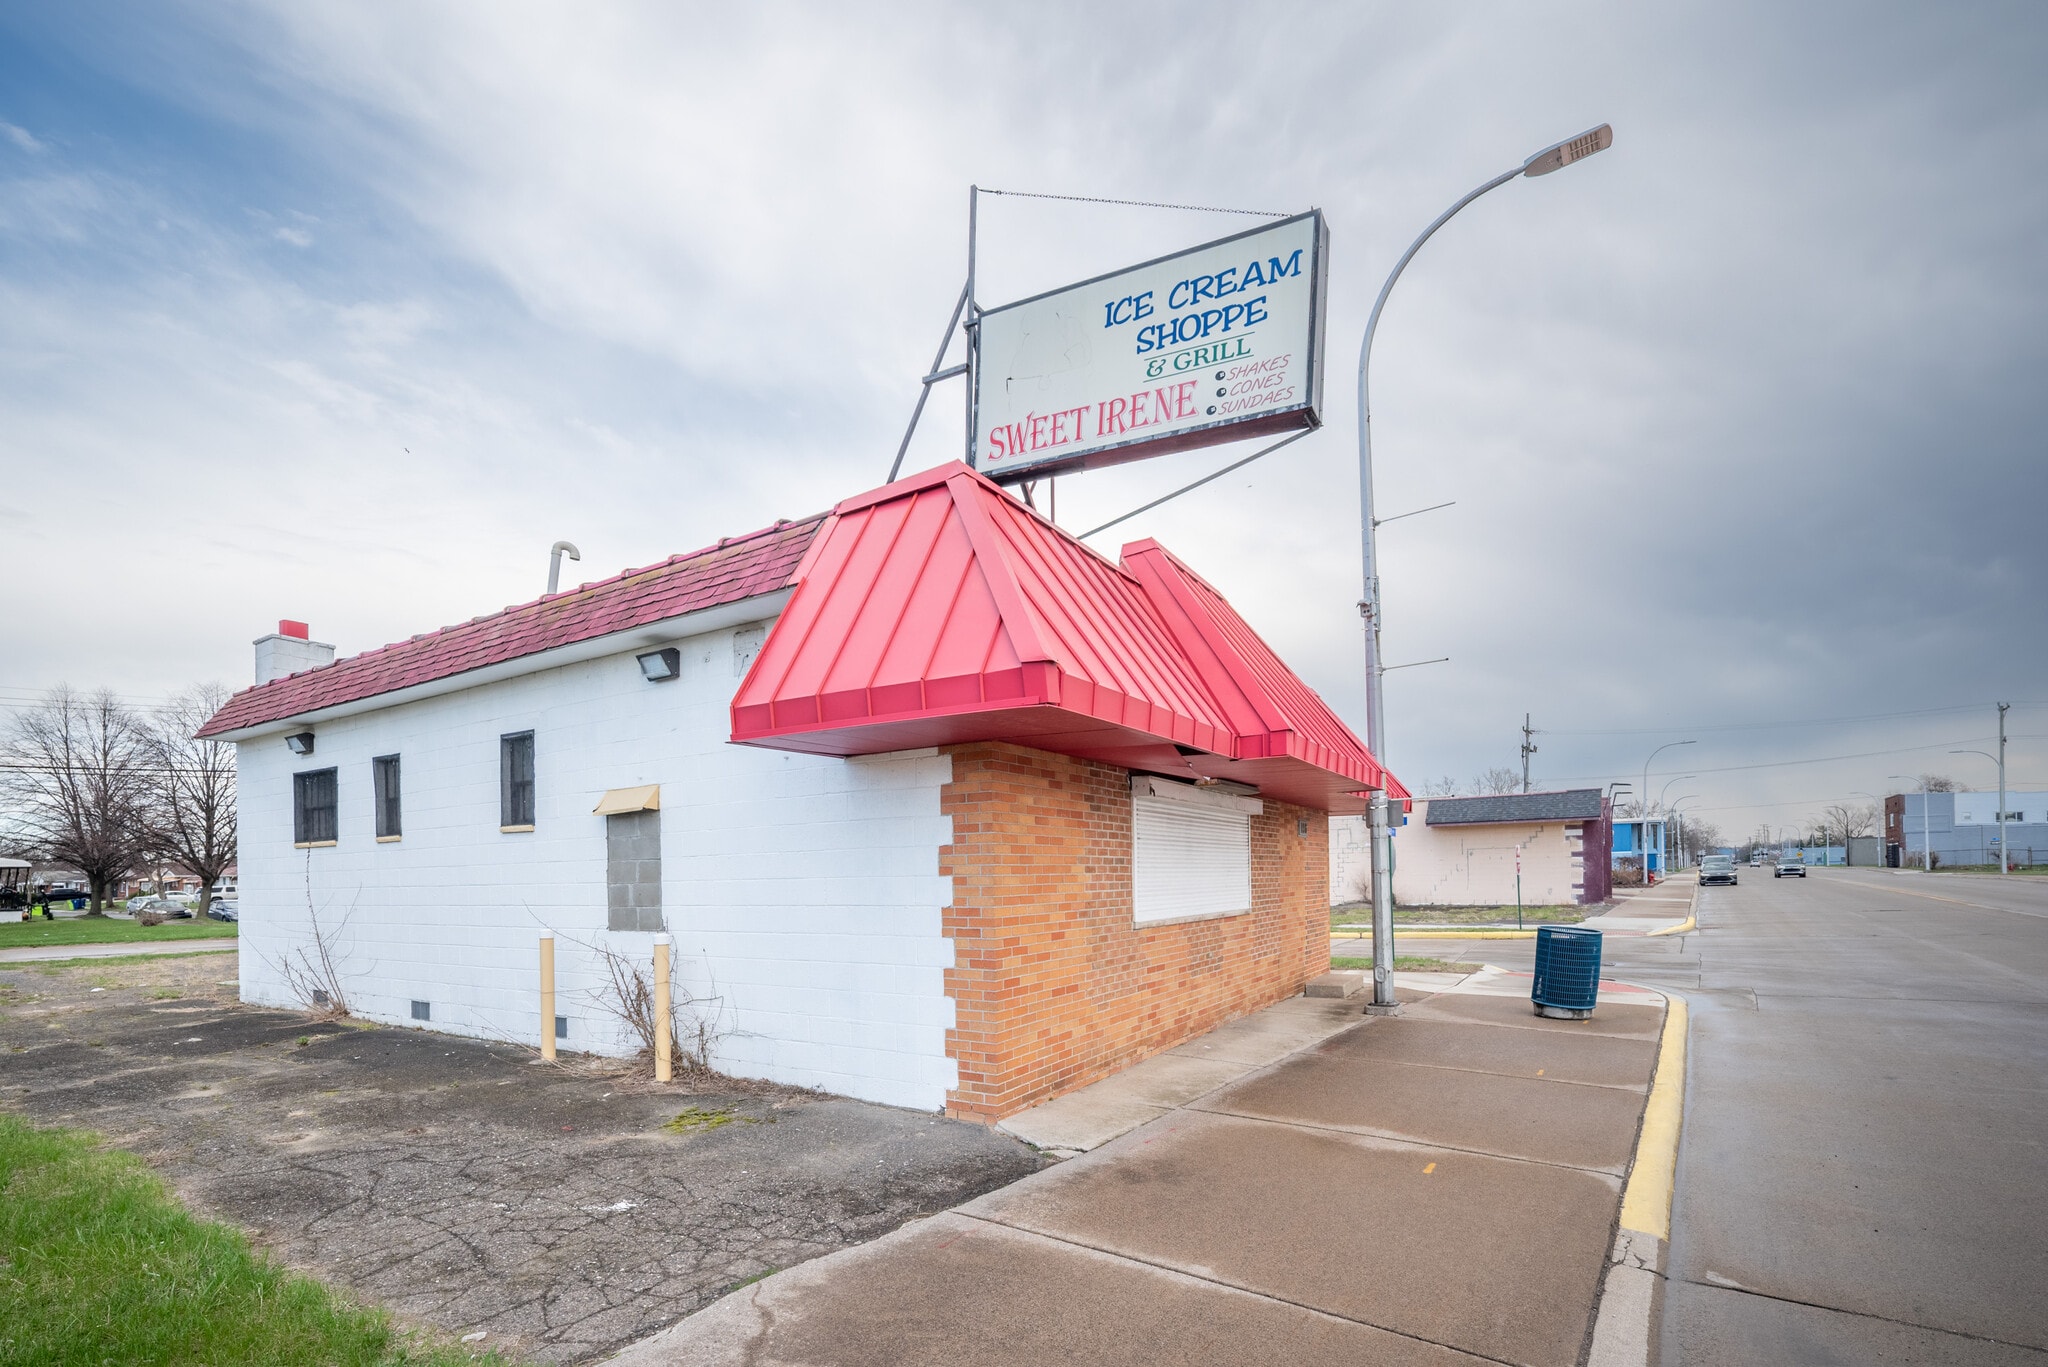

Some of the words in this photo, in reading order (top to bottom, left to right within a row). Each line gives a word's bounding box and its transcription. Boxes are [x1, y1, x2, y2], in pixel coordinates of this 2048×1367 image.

[1104, 291, 1154, 328] ICE
[1168, 249, 1303, 310] CREAM
[1136, 295, 1268, 354] SHOPPE
[1146, 358, 1167, 378] &
[1173, 338, 1251, 371] GRILL
[1226, 354, 1292, 381] SHAKES
[1217, 386, 1296, 416] SUNDAES
[1229, 372, 1286, 397] CONES
[987, 405, 1091, 461] SWEET
[1096, 379, 1200, 438] IRENE
